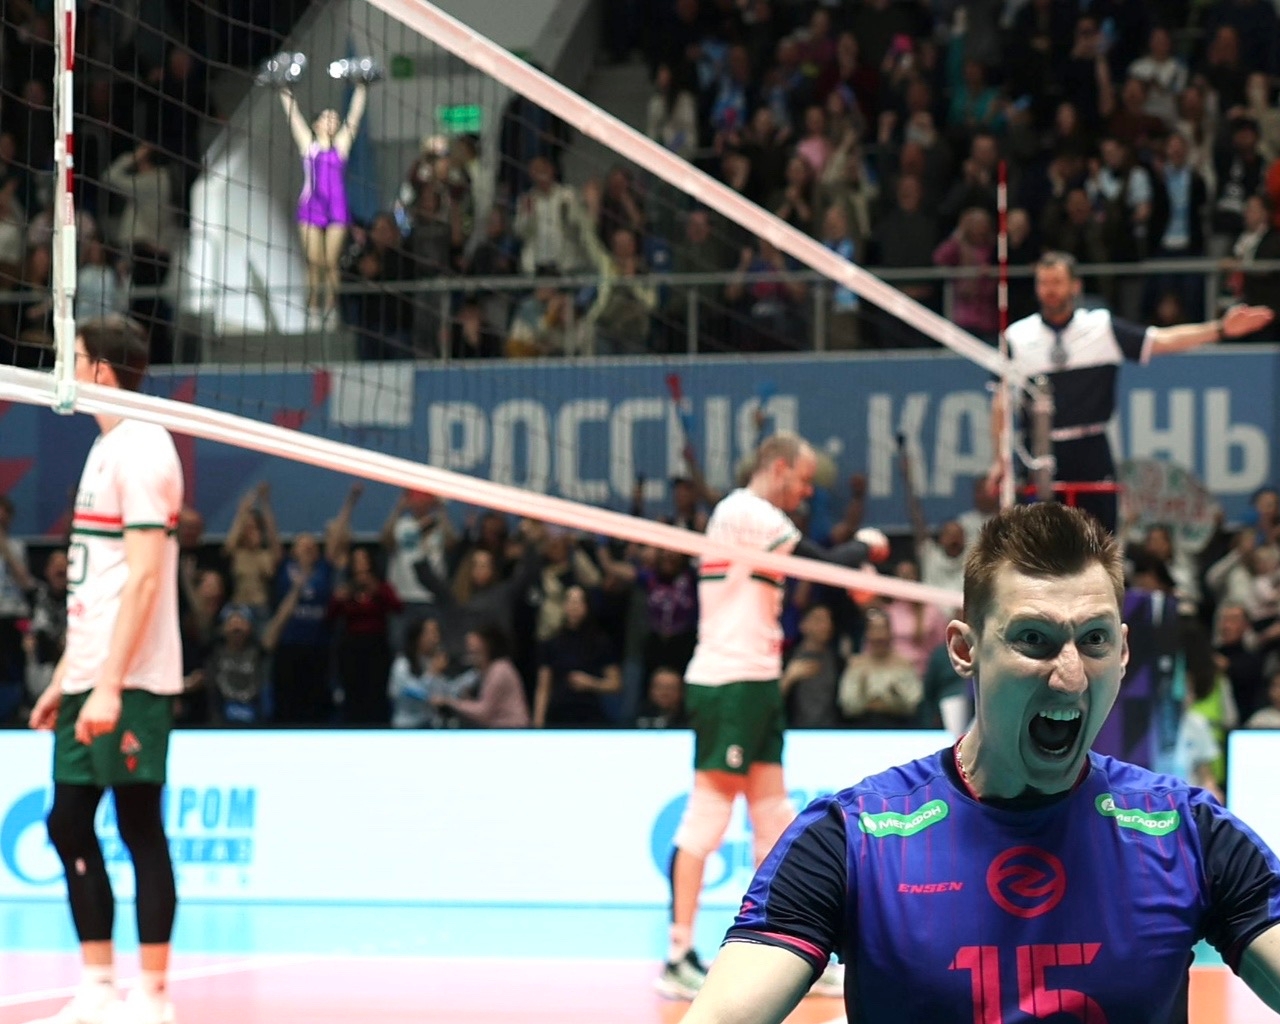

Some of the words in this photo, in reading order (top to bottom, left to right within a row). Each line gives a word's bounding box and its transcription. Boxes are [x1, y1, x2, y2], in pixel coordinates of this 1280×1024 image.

[867, 387, 1270, 497] КАНЬ
[879, 805, 942, 830] МЕГАФОН
[898, 882, 964, 894] ENSEN
